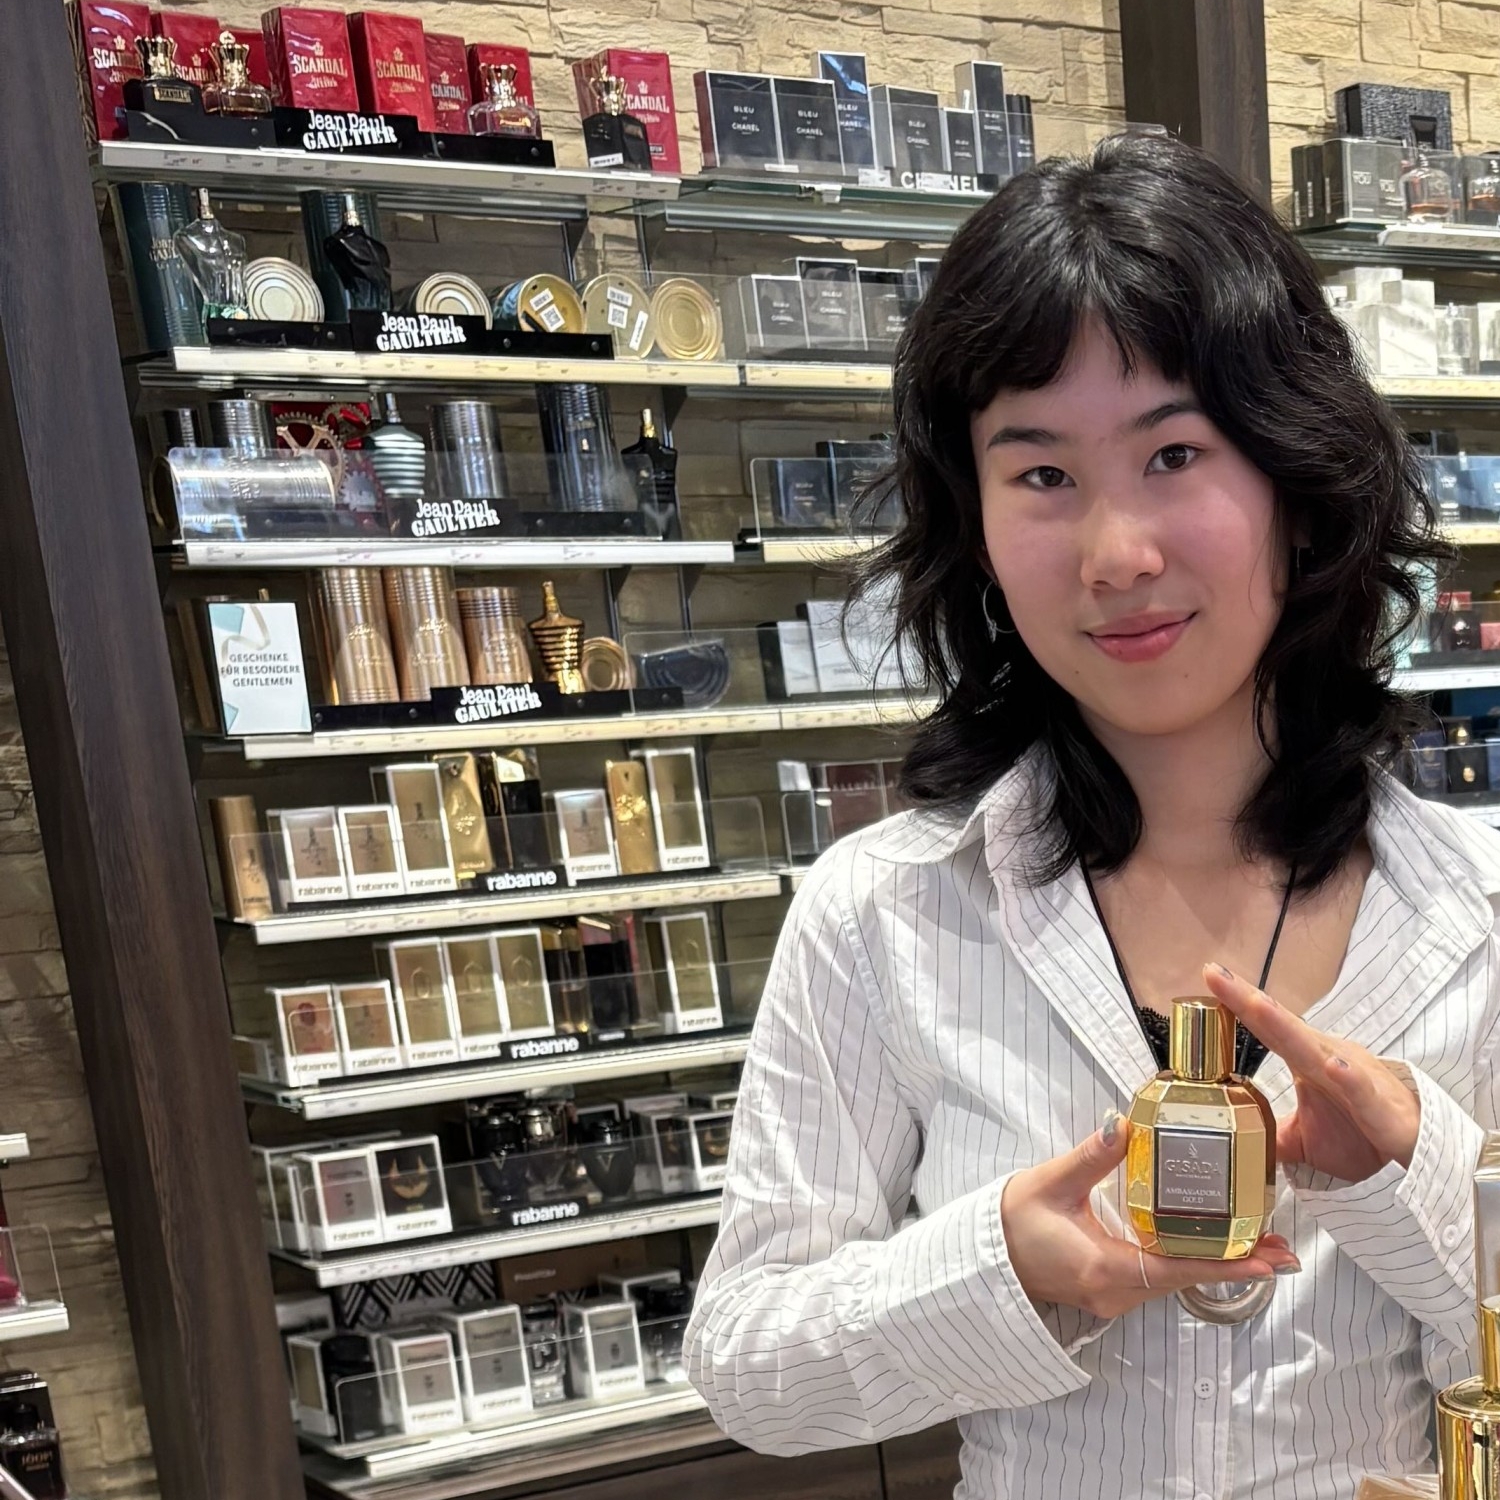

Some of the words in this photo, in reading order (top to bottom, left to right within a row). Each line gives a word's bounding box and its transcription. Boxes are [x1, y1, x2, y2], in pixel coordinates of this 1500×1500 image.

[292, 55, 348, 78] SCANDAL
[375, 60, 425, 83] SCANDAL
[308, 112, 345, 131] Jean
[347, 112, 387, 133] Paul
[302, 124, 398, 150] GAULTIER
[901, 171, 987, 192] CHNEL
[381, 312, 417, 332] Jean
[418, 314, 456, 334] Paul
[376, 325, 467, 351] GAULTIER
[416, 498, 452, 518] Jean
[453, 499, 489, 517] Paul
[411, 508, 501, 537] GAULTIER
[229, 653, 289, 663] GESCHENKE
[243, 665, 301, 675] BESONDERE
[233, 677, 293, 687] GENTLEMEN
[460, 686, 496, 706] Jean
[496, 683, 532, 702] Paul
[455, 694, 543, 723] GAULTIER
[487, 870, 557, 890] rabanne
[511, 1037, 579, 1059] rabanne
[513, 1202, 580, 1226] rabanne
